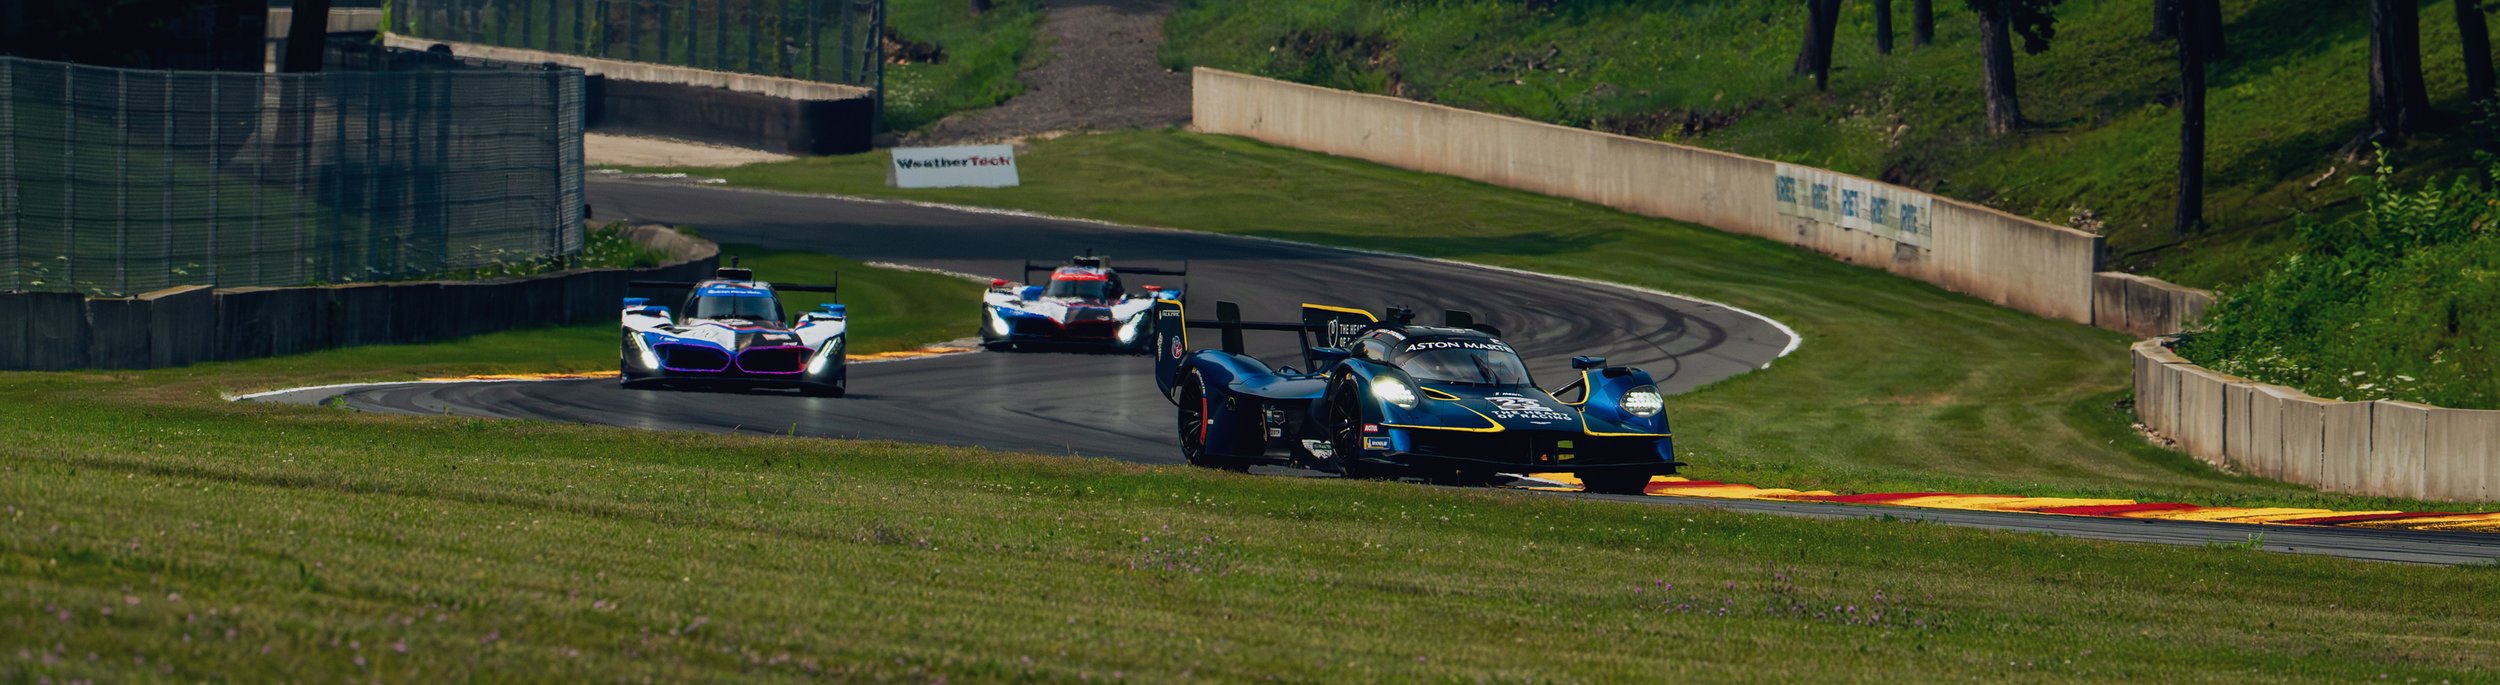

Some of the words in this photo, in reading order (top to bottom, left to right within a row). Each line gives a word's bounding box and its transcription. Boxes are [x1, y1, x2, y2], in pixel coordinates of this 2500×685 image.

[897, 155, 1011, 169] WeatherTech
[1340, 324, 1349, 335] THE
[1405, 342, 1460, 353] ASTON
